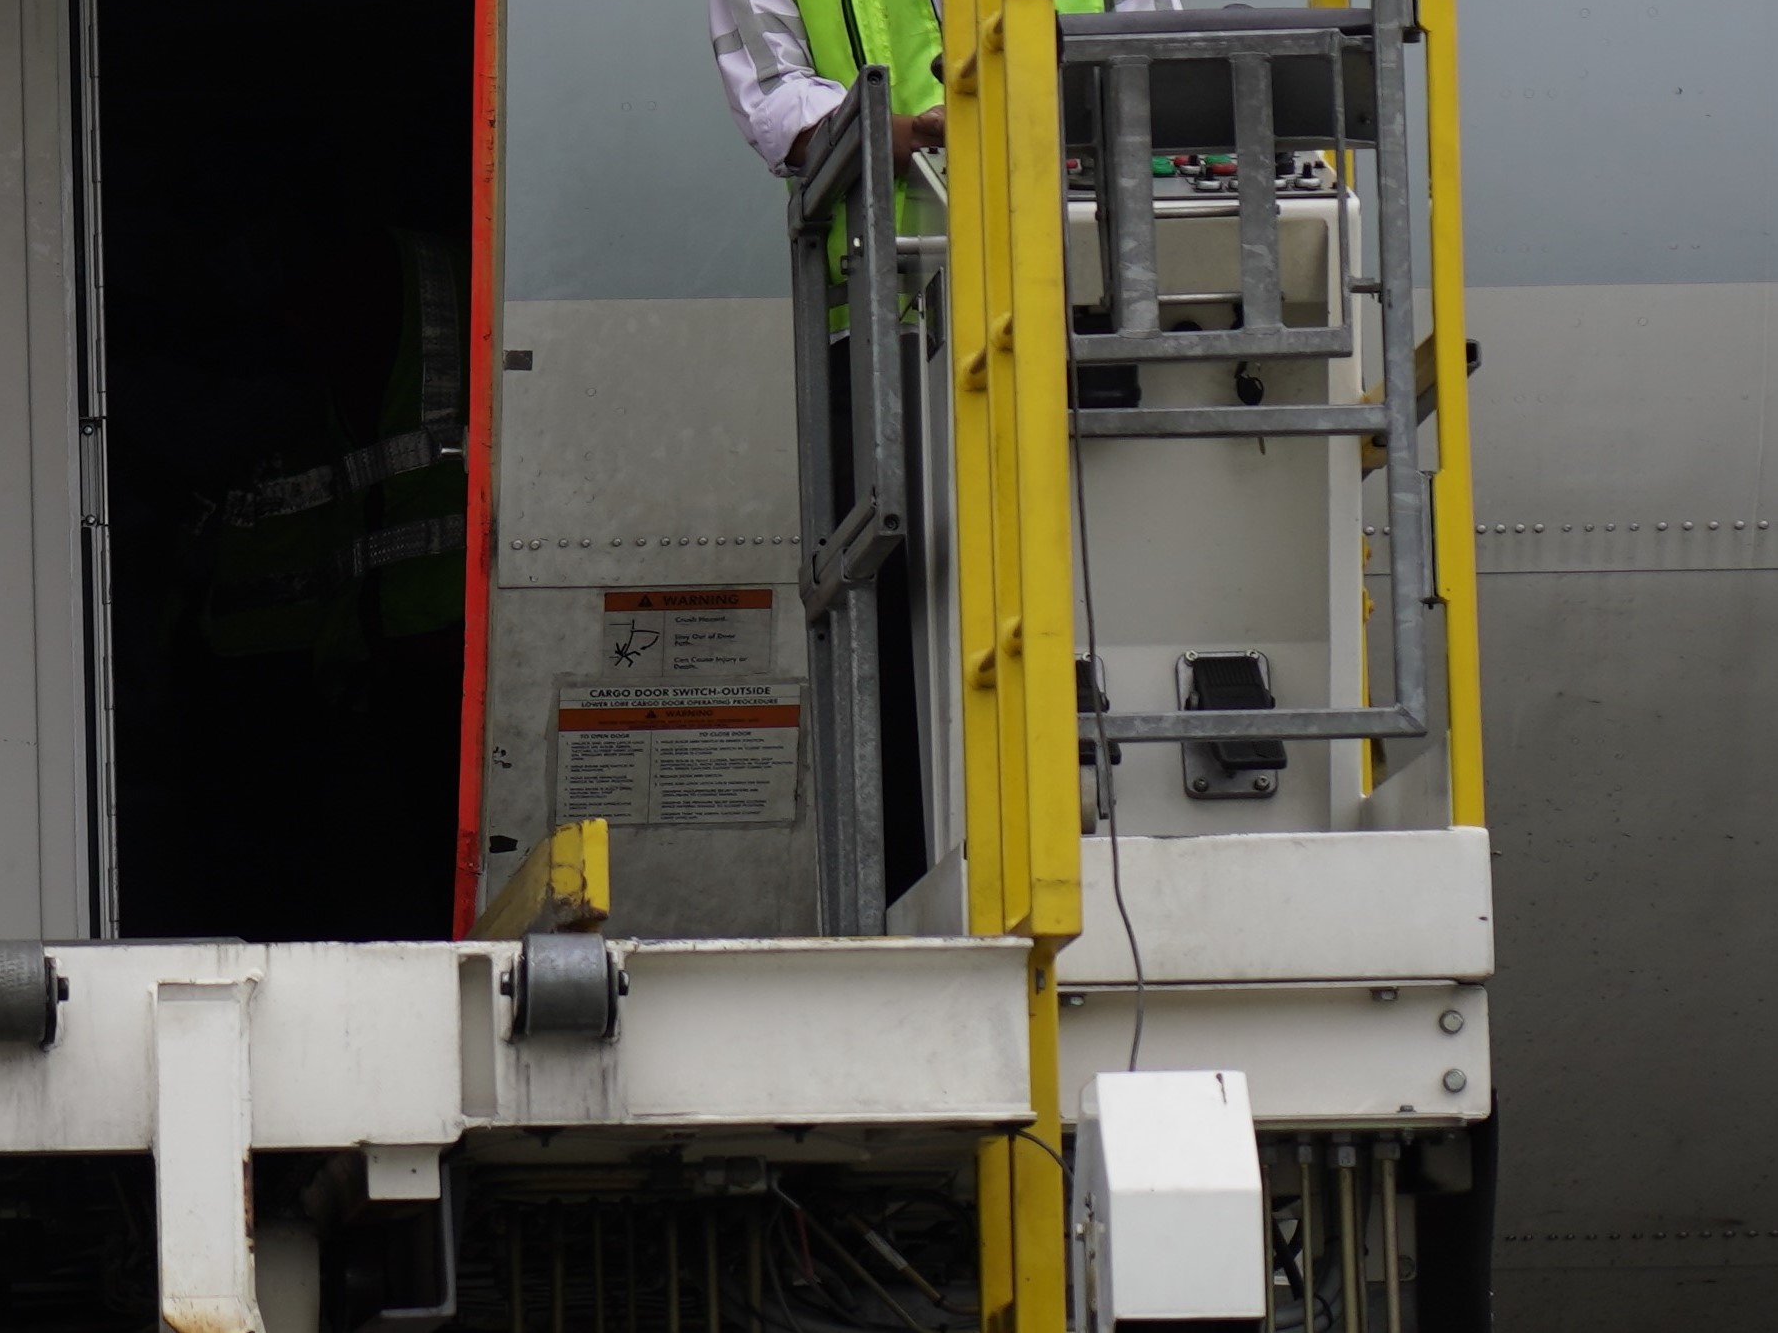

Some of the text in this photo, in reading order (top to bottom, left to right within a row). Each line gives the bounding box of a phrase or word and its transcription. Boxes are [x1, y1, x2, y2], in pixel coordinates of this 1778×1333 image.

[663, 594, 740, 607] WARNING
[589, 689, 631, 698] CARGO
[634, 688, 669, 697] DOOR
[666, 709, 714, 717] WARNING
